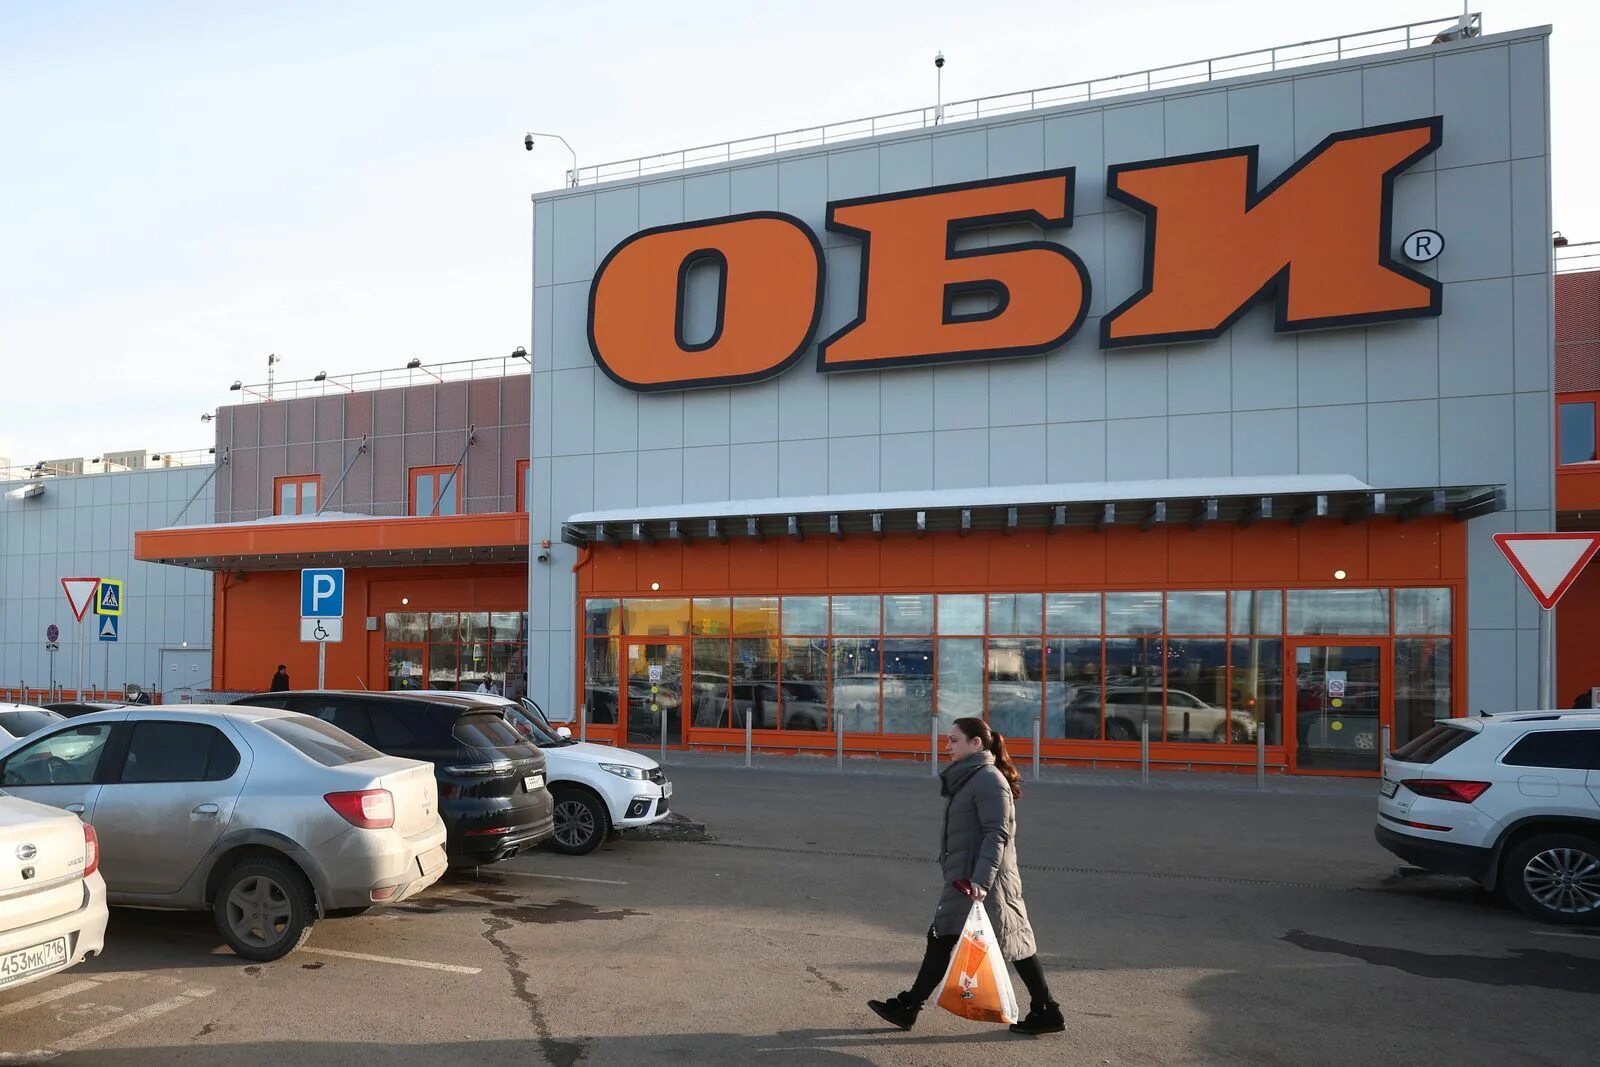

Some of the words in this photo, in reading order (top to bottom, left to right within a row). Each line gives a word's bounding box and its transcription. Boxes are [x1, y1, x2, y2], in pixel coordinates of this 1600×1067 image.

[587, 115, 1443, 391] ОБИ
[312, 574, 336, 612] P
[45, 940, 64, 958] 716
